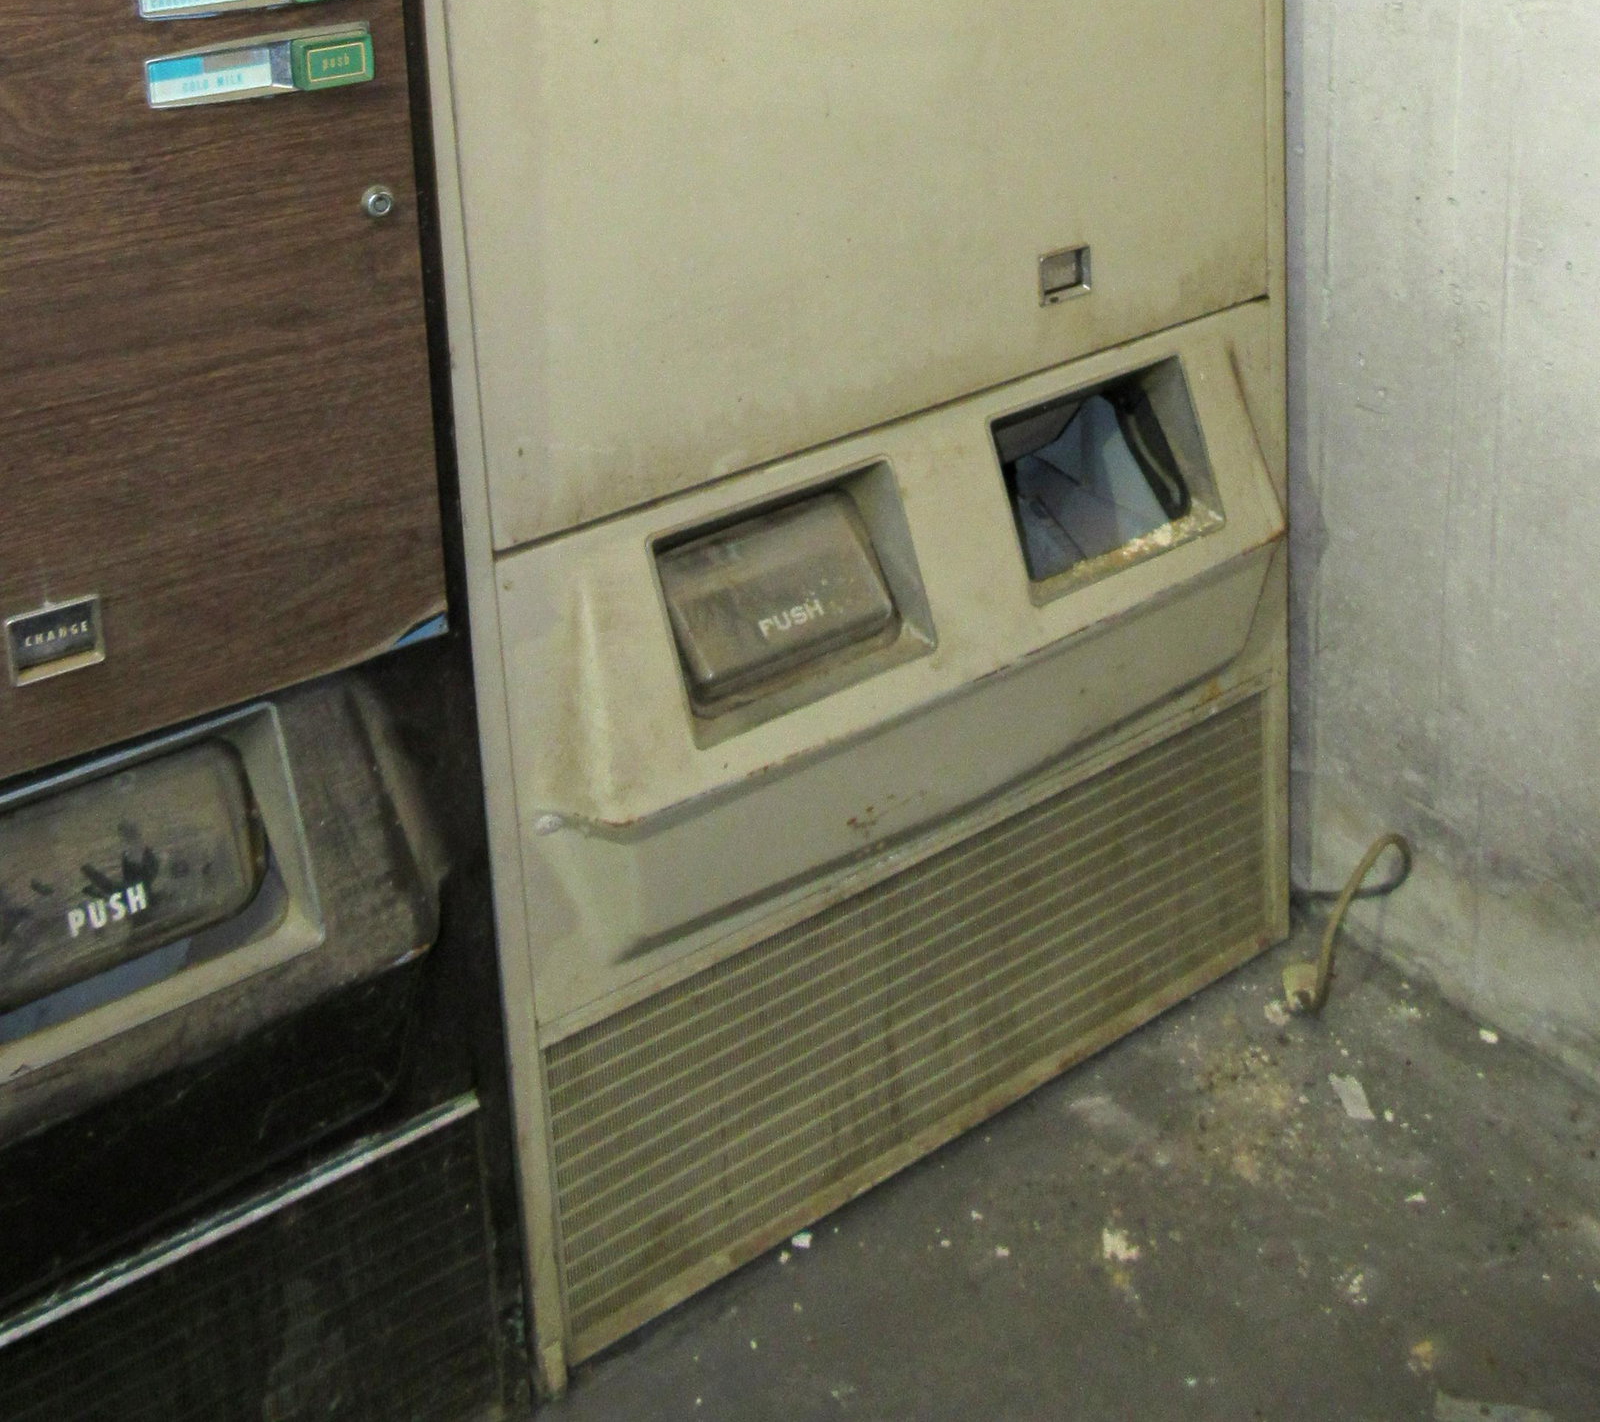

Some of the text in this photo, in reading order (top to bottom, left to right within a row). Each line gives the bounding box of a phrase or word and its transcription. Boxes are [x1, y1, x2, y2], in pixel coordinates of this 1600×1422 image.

[322, 53, 350, 70] push
[25, 620, 89, 647] CHANGE
[758, 597, 825, 638] PUSH
[67, 882, 148, 938] PUSH
